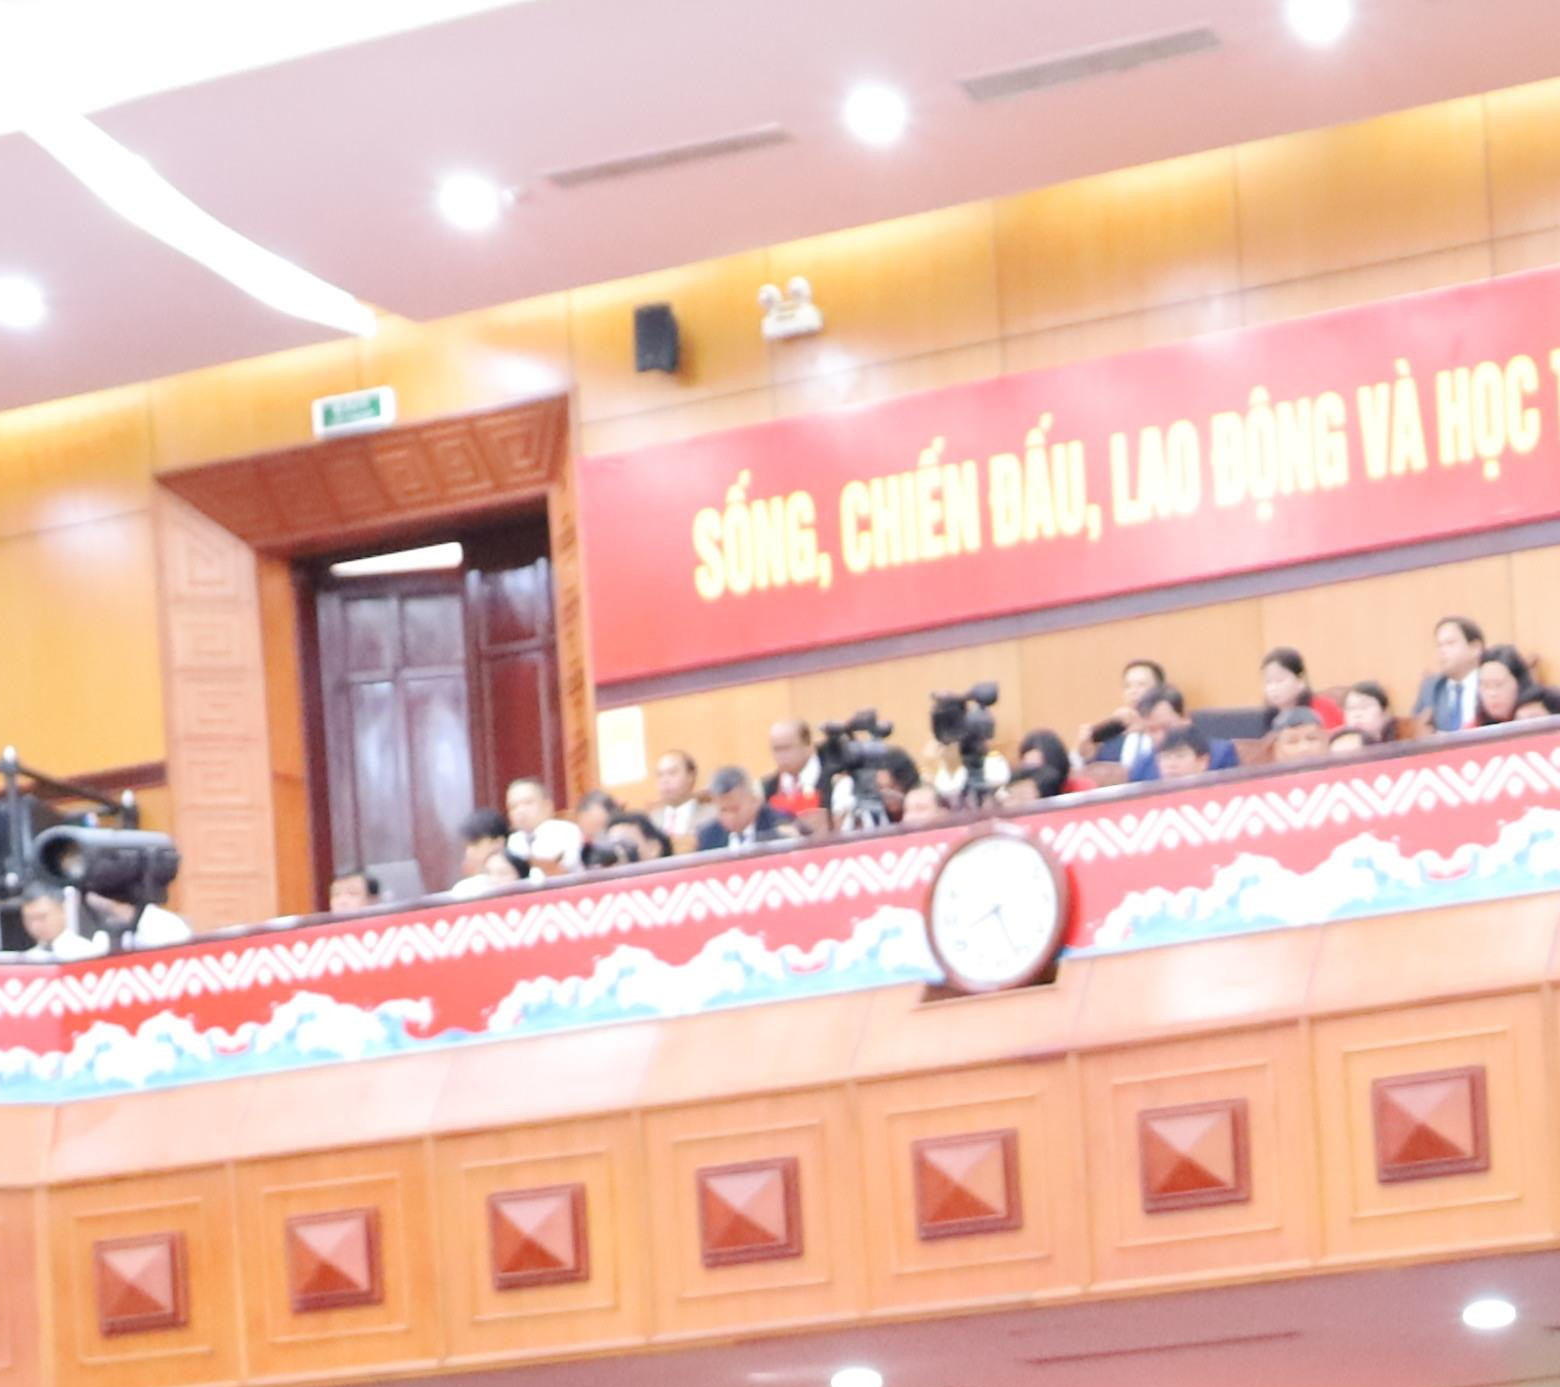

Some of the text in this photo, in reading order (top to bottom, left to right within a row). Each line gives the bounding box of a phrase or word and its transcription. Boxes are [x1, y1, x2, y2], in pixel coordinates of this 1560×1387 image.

[693, 469, 831, 600] SỐNG,
[841, 436, 981, 573] CHIẾN
[988, 412, 1101, 548] ĐẤU,
[1111, 420, 1199, 525] LAO
[1211, 385, 1348, 520] ĐỘNG
[1358, 358, 1427, 480] VÀ
[1436, 354, 1539, 481] HỌC
